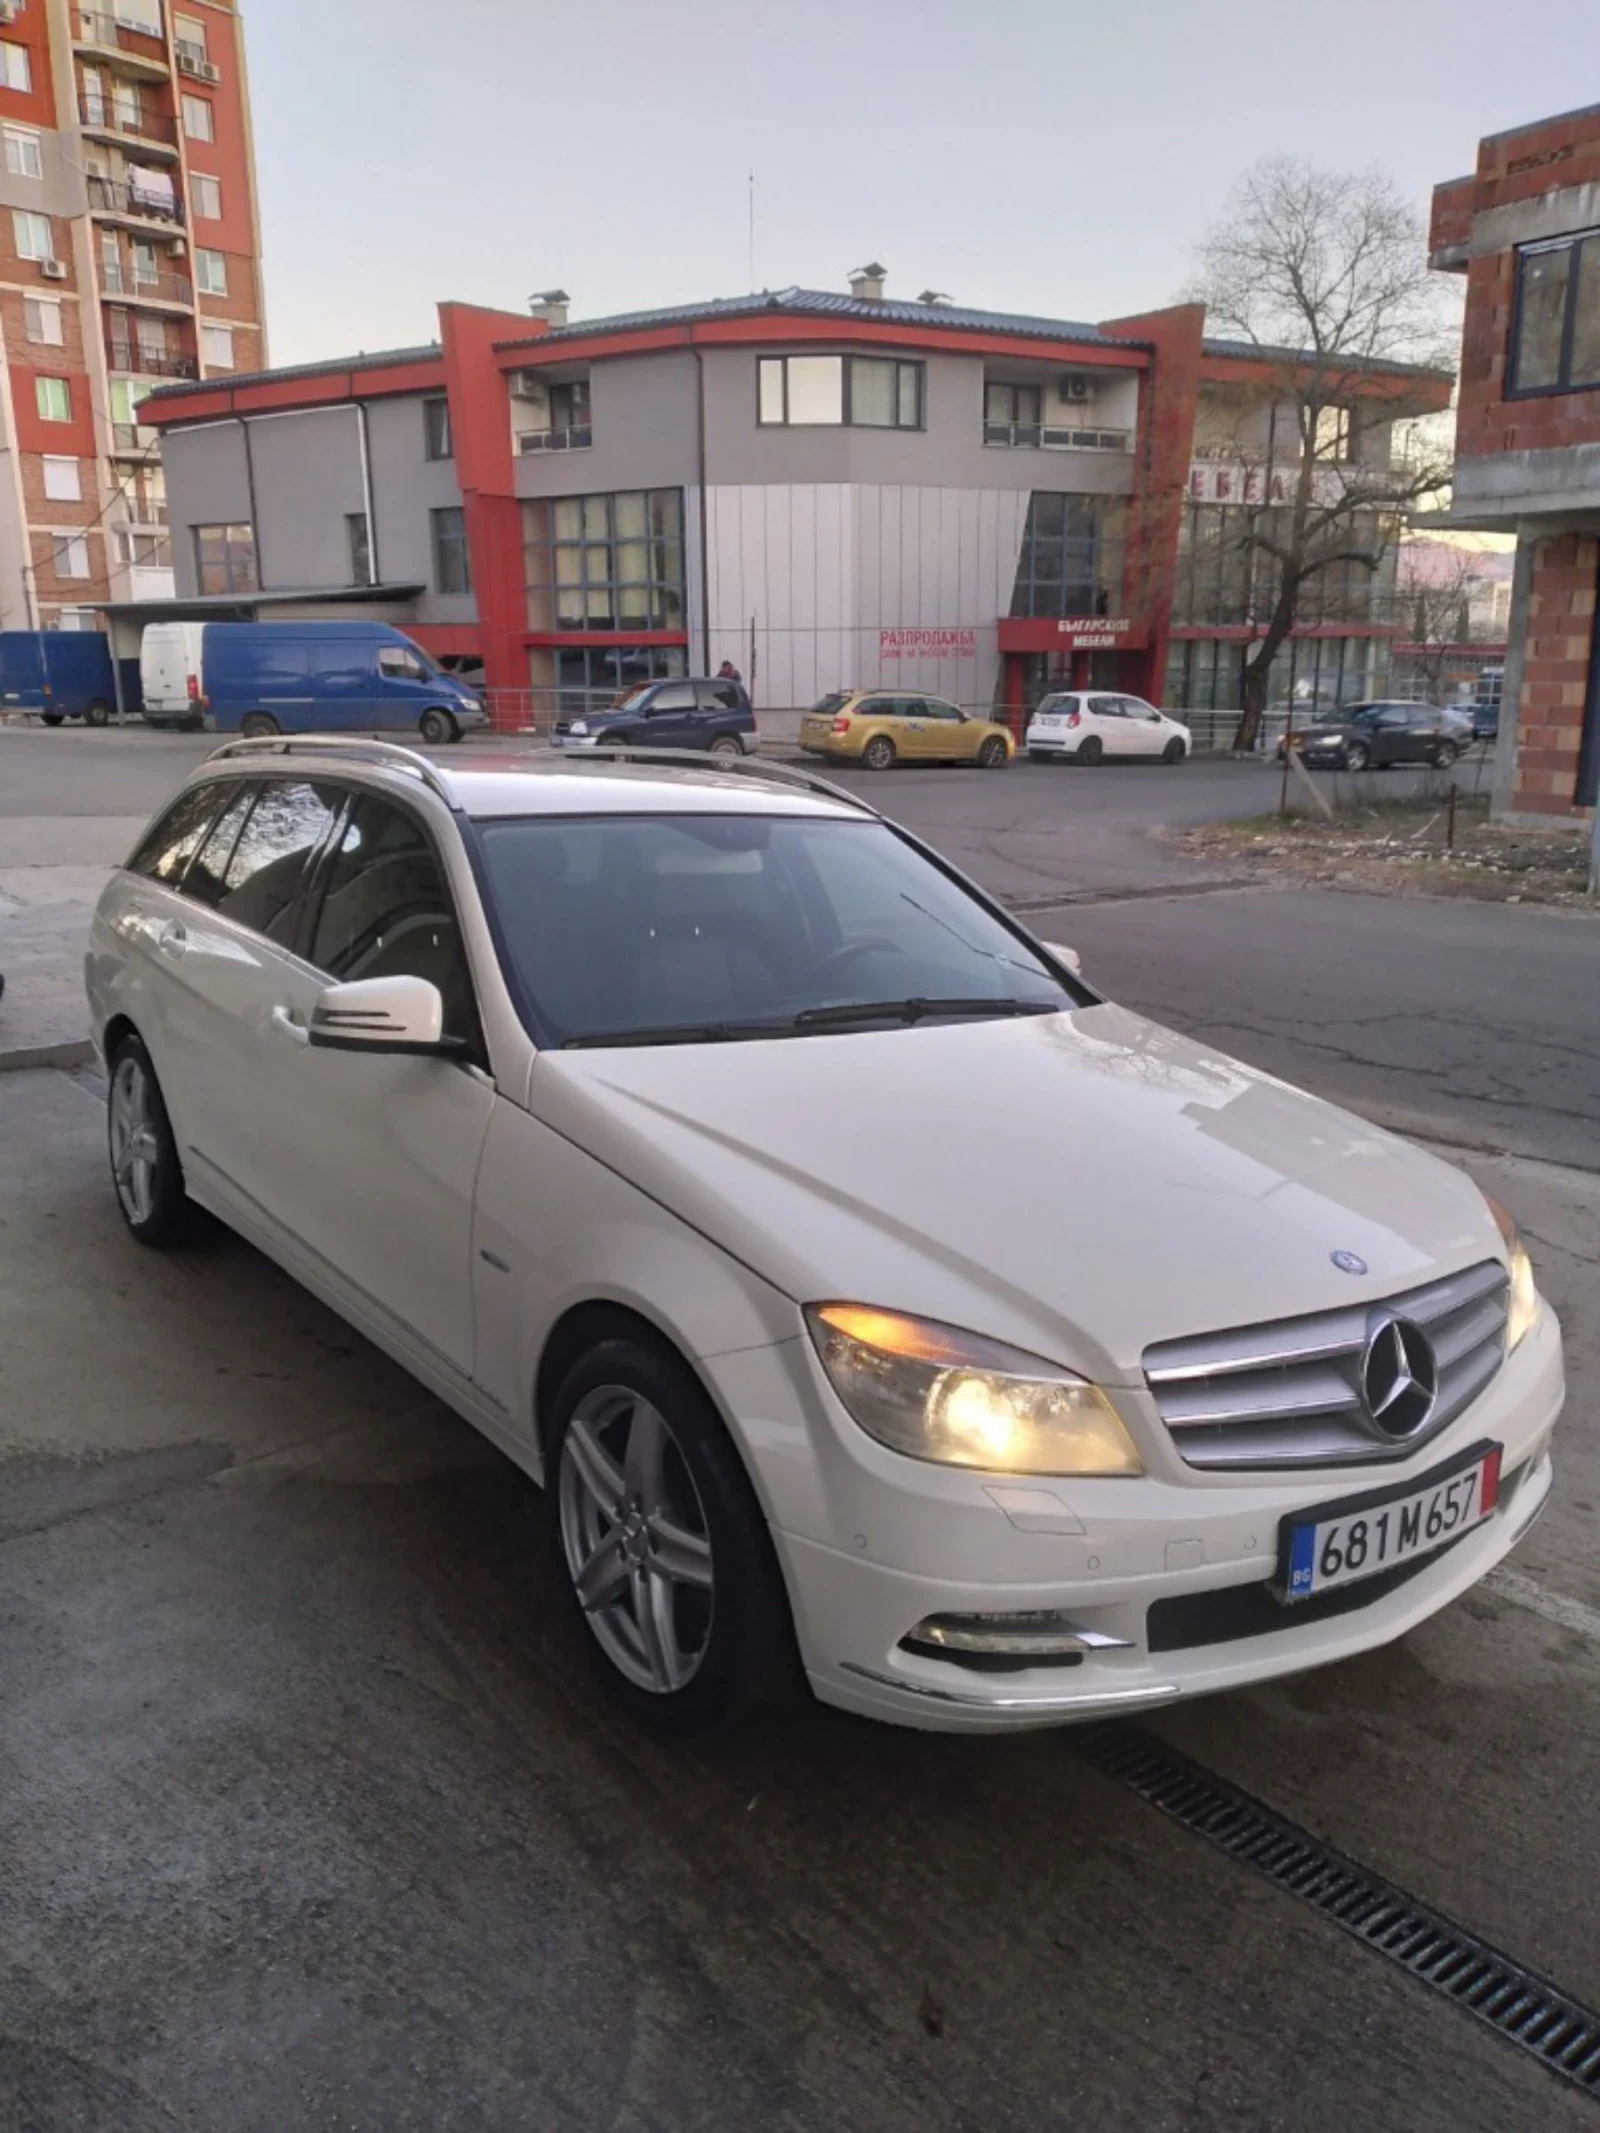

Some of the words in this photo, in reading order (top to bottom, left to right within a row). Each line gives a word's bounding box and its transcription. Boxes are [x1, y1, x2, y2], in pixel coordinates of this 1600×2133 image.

[1190, 469, 1313, 501] ЕБЕЛ
[1073, 635, 1116, 647] МЕБЕЛИ
[1293, 1567, 1311, 1586] BG
